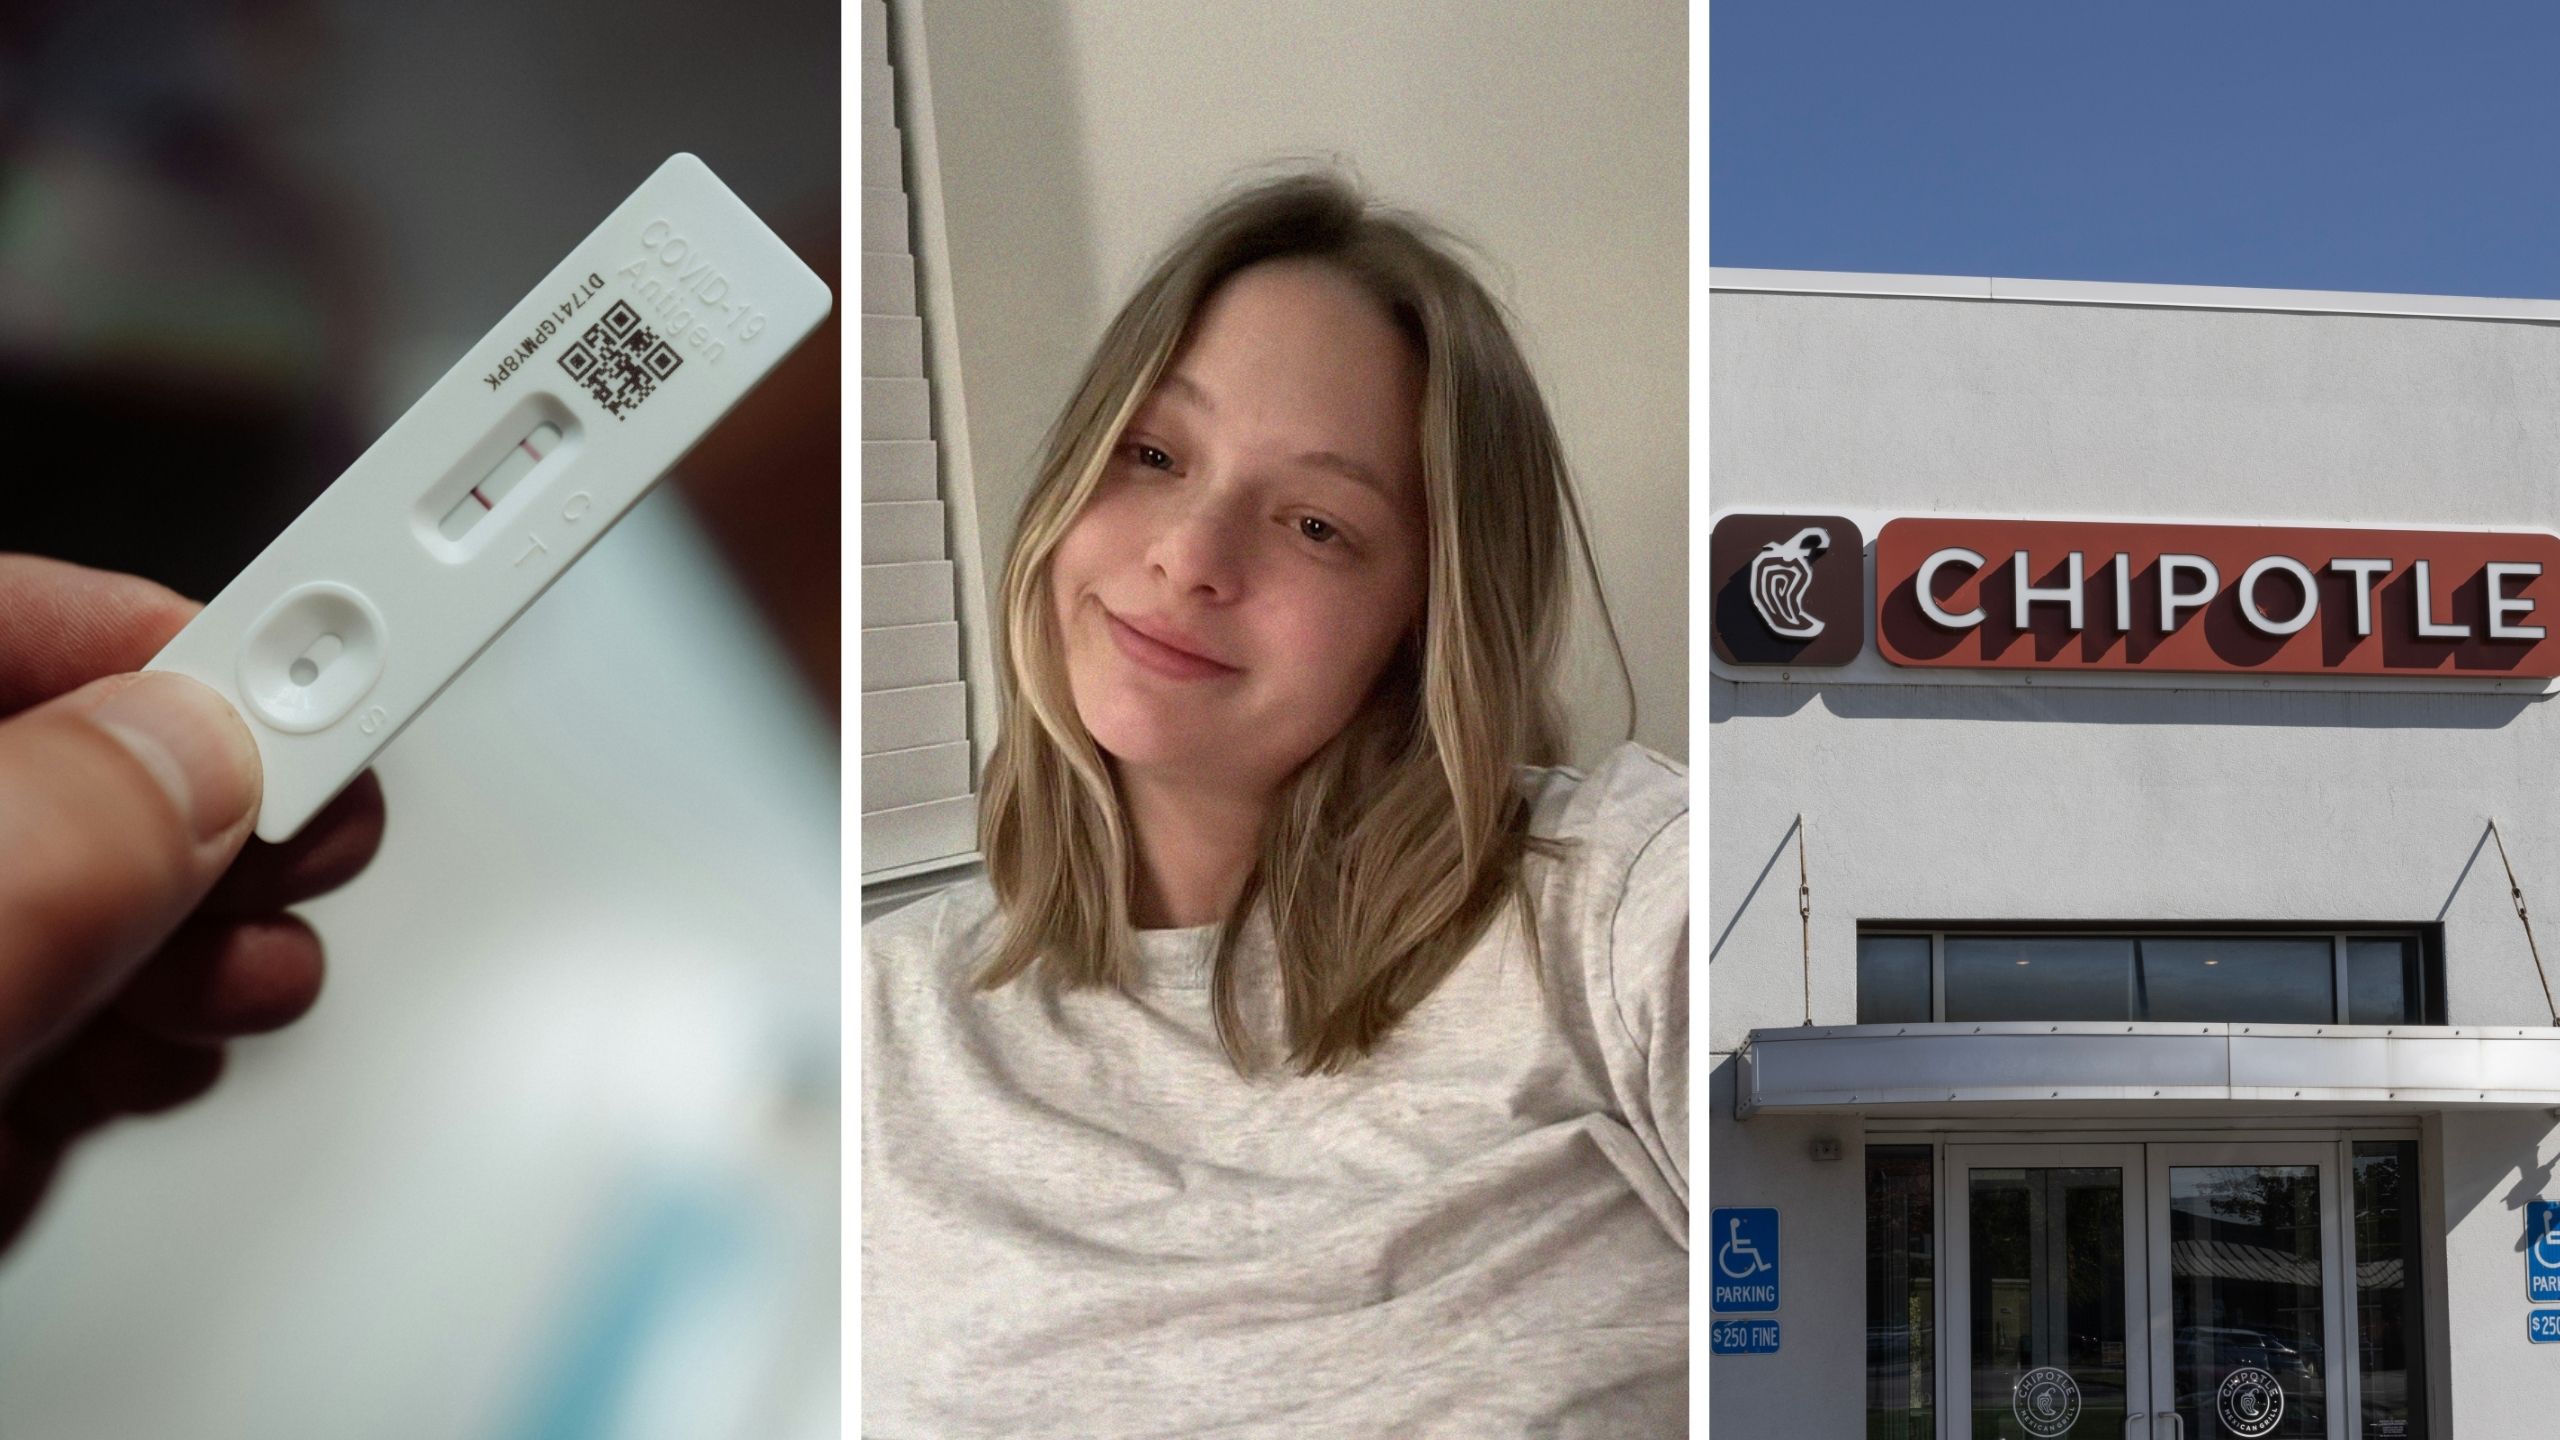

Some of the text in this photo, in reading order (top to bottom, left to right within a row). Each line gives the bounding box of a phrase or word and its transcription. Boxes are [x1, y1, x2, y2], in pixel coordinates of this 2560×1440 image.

[641, 219, 767, 342] COVID-19
[617, 259, 726, 365] Antigen
[484, 272, 605, 391] DT741GPMY8PK
[562, 491, 592, 523] C
[514, 533, 547, 567] T
[1914, 546, 2547, 641] CHIPOTLE
[1716, 1286, 1775, 1303] PARKING
[1752, 1327, 1778, 1347] FINE
[2018, 1371, 2075, 1398] CHIPOTLE
[2222, 1372, 2279, 1397] CHIPOTLE
[2020, 1407, 2075, 1432] MEXICAN GRILL
[2224, 1408, 2278, 1432] MEXICAN GRILL
